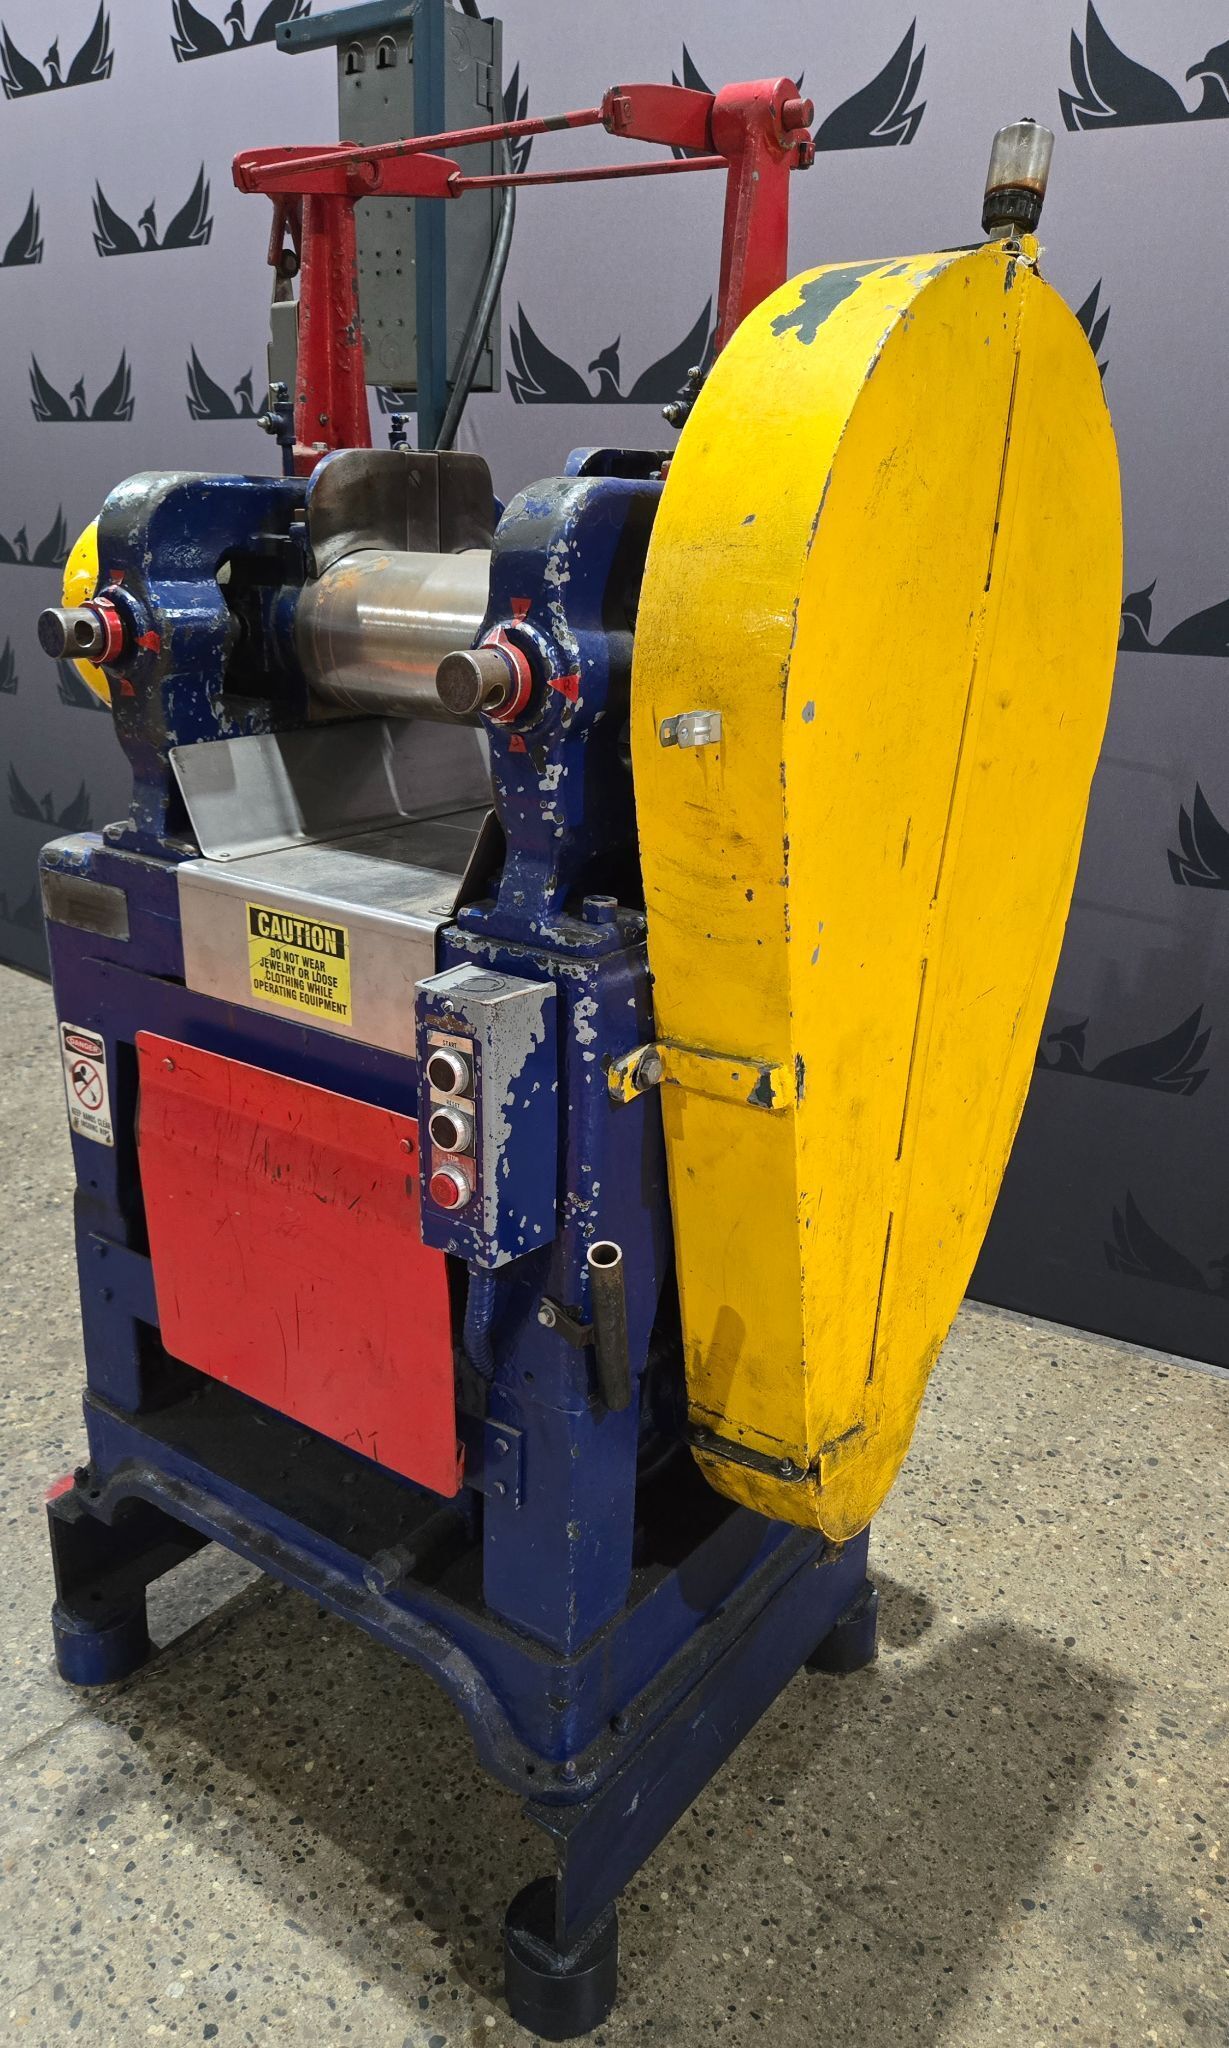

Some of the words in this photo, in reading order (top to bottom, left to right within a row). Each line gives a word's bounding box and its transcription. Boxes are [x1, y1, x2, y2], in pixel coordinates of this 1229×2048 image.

[258, 912, 337, 954] CAUTION
[259, 957, 296, 976] JEWELRY
[298, 967, 310, 980] OR
[312, 970, 338, 988] LOOSE
[270, 947, 281, 960] DO
[283, 951, 299, 965] NOT
[302, 955, 326, 972] WEAR
[253, 978, 297, 1001] OPERATING
[299, 991, 348, 1015] EQUIPMENT
[265, 970, 305, 991] CLOTHING
[307, 981, 333, 999] WHILE
[69, 1038, 98, 1052] DANGER
[443, 1040, 457, 1048] START
[97, 1117, 112, 1131] CLEAR
